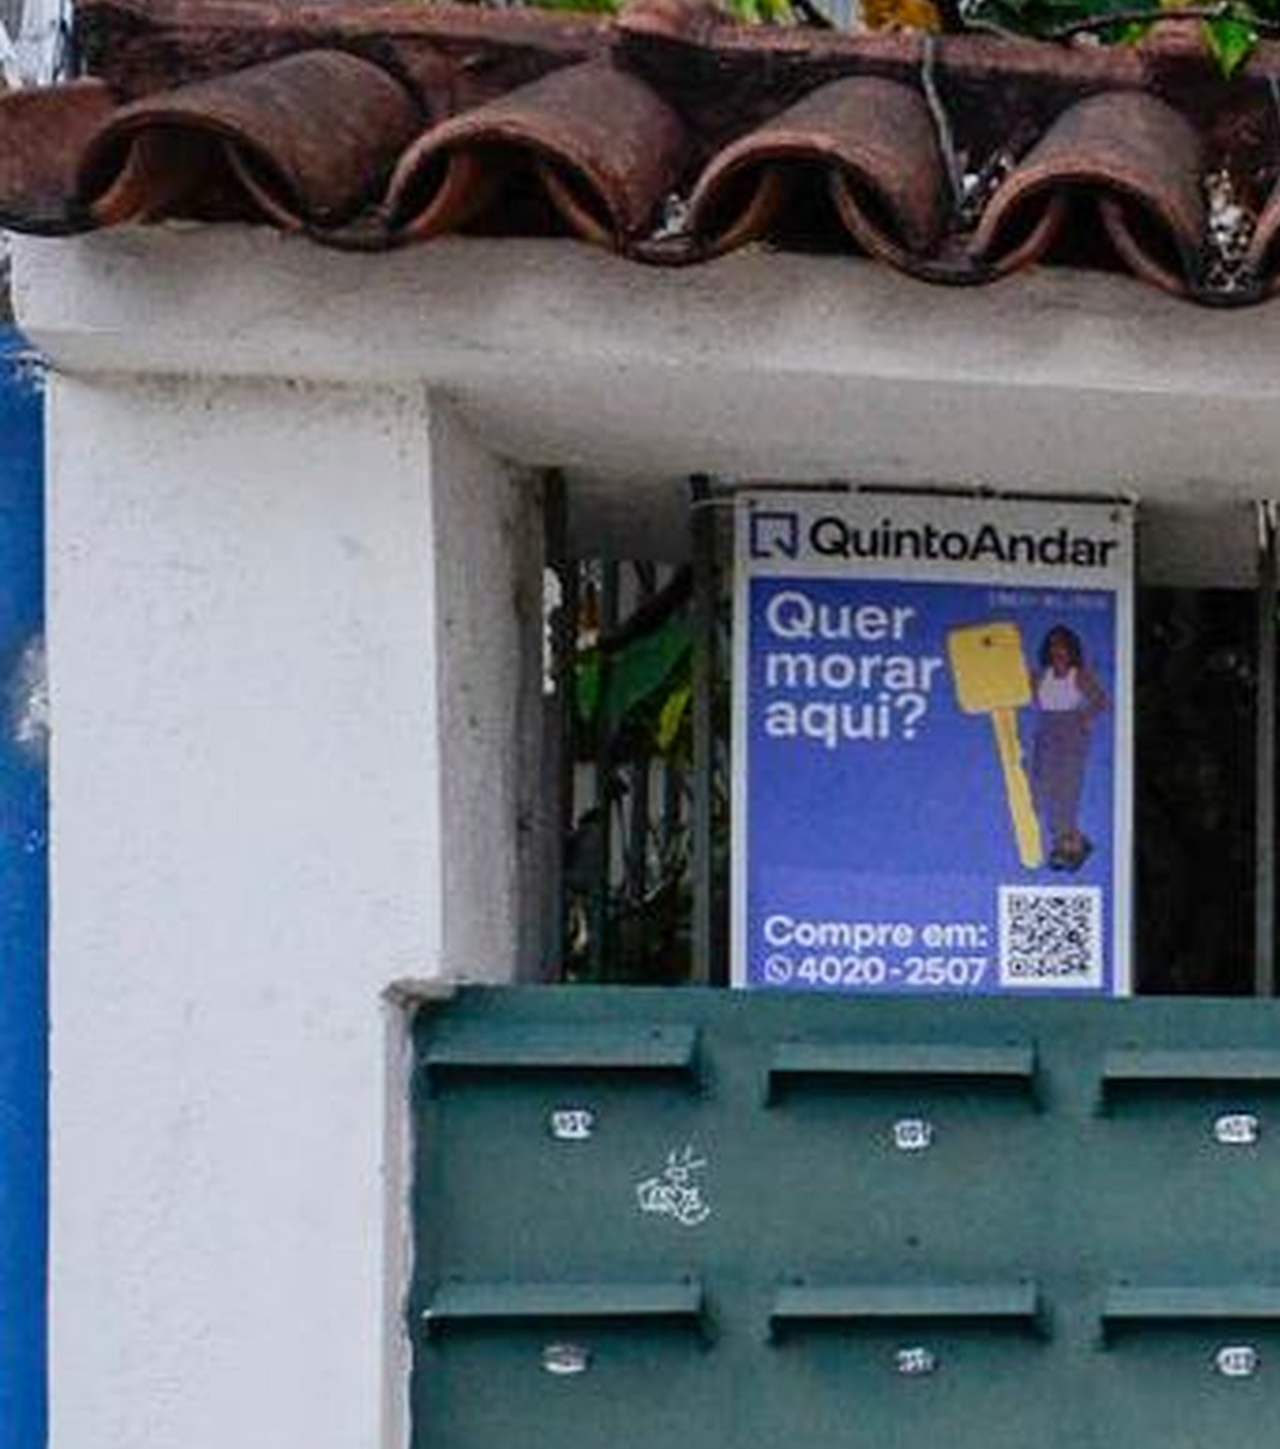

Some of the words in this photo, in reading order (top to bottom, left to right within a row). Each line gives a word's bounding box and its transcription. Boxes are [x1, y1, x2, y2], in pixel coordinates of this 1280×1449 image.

[809, 517, 1118, 567] QuintoAndar
[766, 591, 915, 640] Quer
[767, 649, 943, 691] morar
[765, 694, 927, 749] aqui?
[764, 915, 913, 951] Compre
[922, 920, 988, 948] em:
[797, 954, 986, 986] 4020-2507
